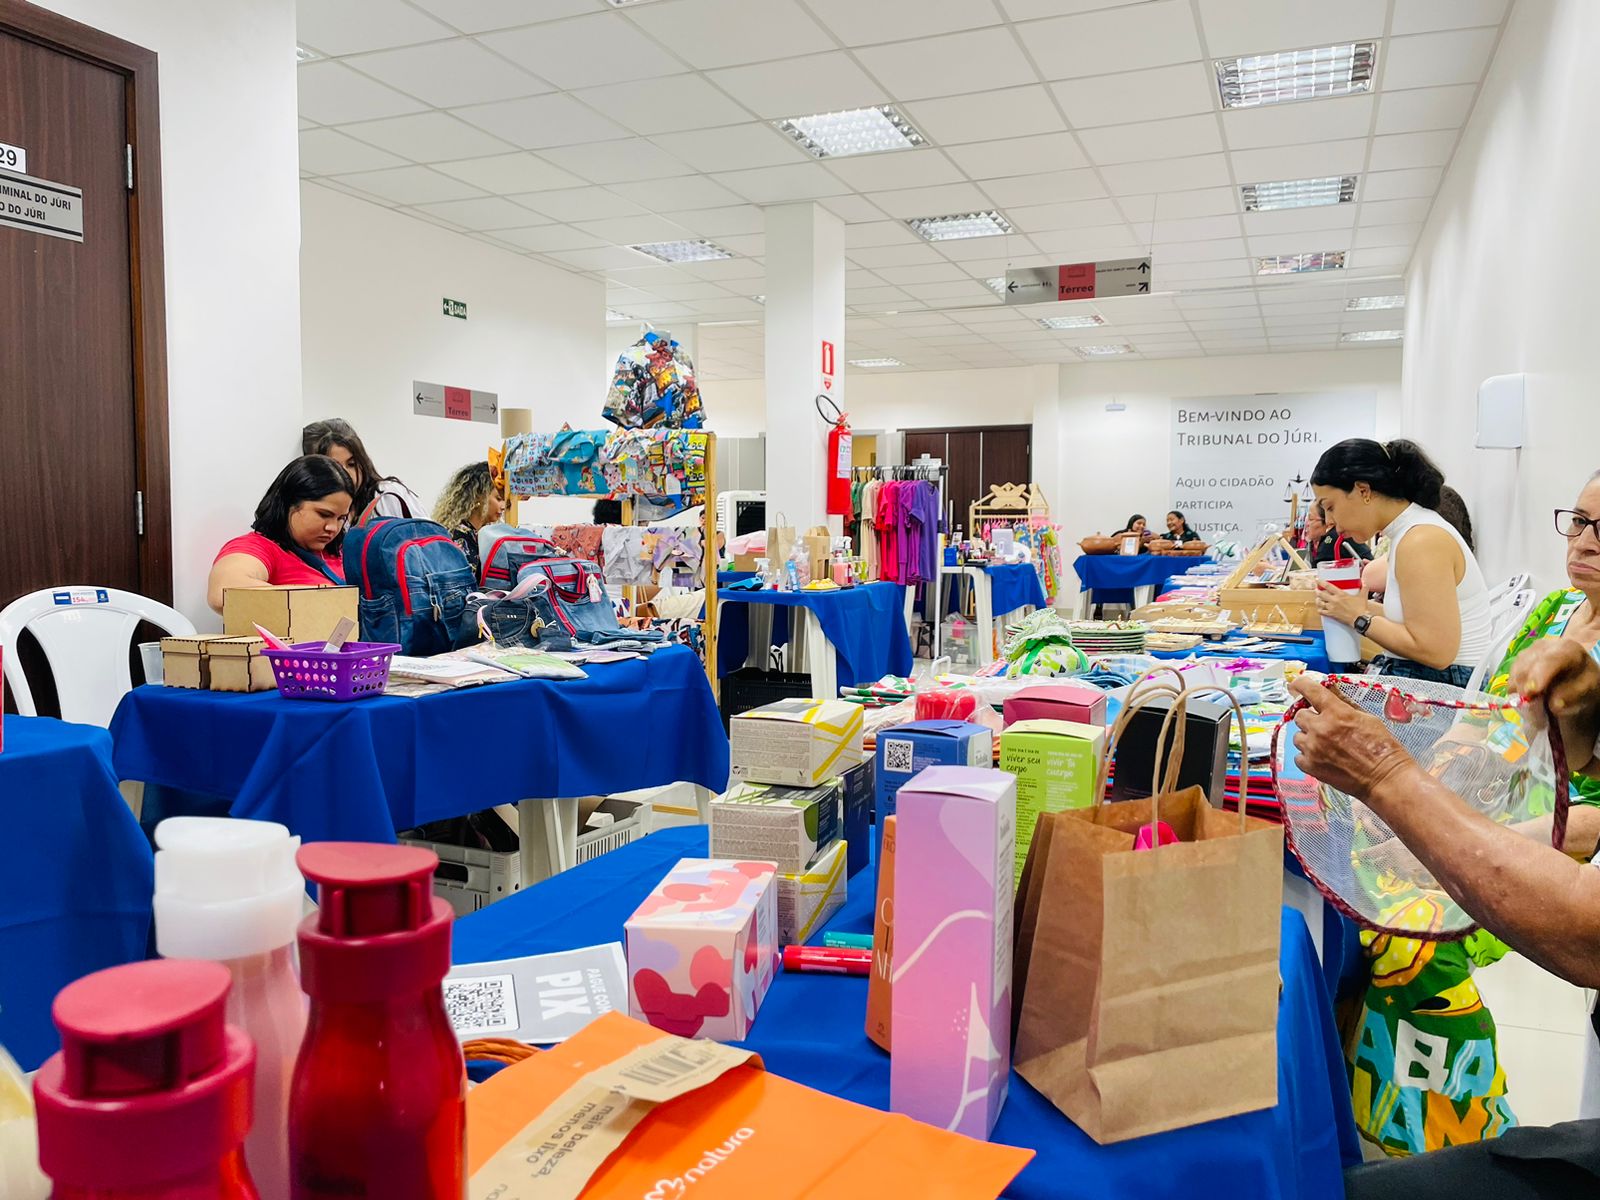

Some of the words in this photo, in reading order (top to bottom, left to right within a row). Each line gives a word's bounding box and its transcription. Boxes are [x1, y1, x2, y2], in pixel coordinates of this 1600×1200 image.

[34, 193, 48, 204] DO
[50, 197, 71, 210] JÚRI
[8, 203, 21, 215] DO
[24, 207, 46, 220] JÚRI
[1269, 408, 1291, 421] AO
[1177, 432, 1253, 446] TRIBUNAL
[1257, 432, 1280, 444] DO
[1175, 477, 1205, 489] AQUI
[1208, 478, 1217, 487] O
[1219, 475, 1274, 487] CIDADÃO
[1175, 500, 1233, 510] PARTICIPA
[535, 970, 592, 1021] PIX
[551, 1101, 597, 1140] menos
[580, 1103, 615, 1134] mais
[525, 1137, 557, 1165] lixo
[683, 1126, 756, 1183] natura
